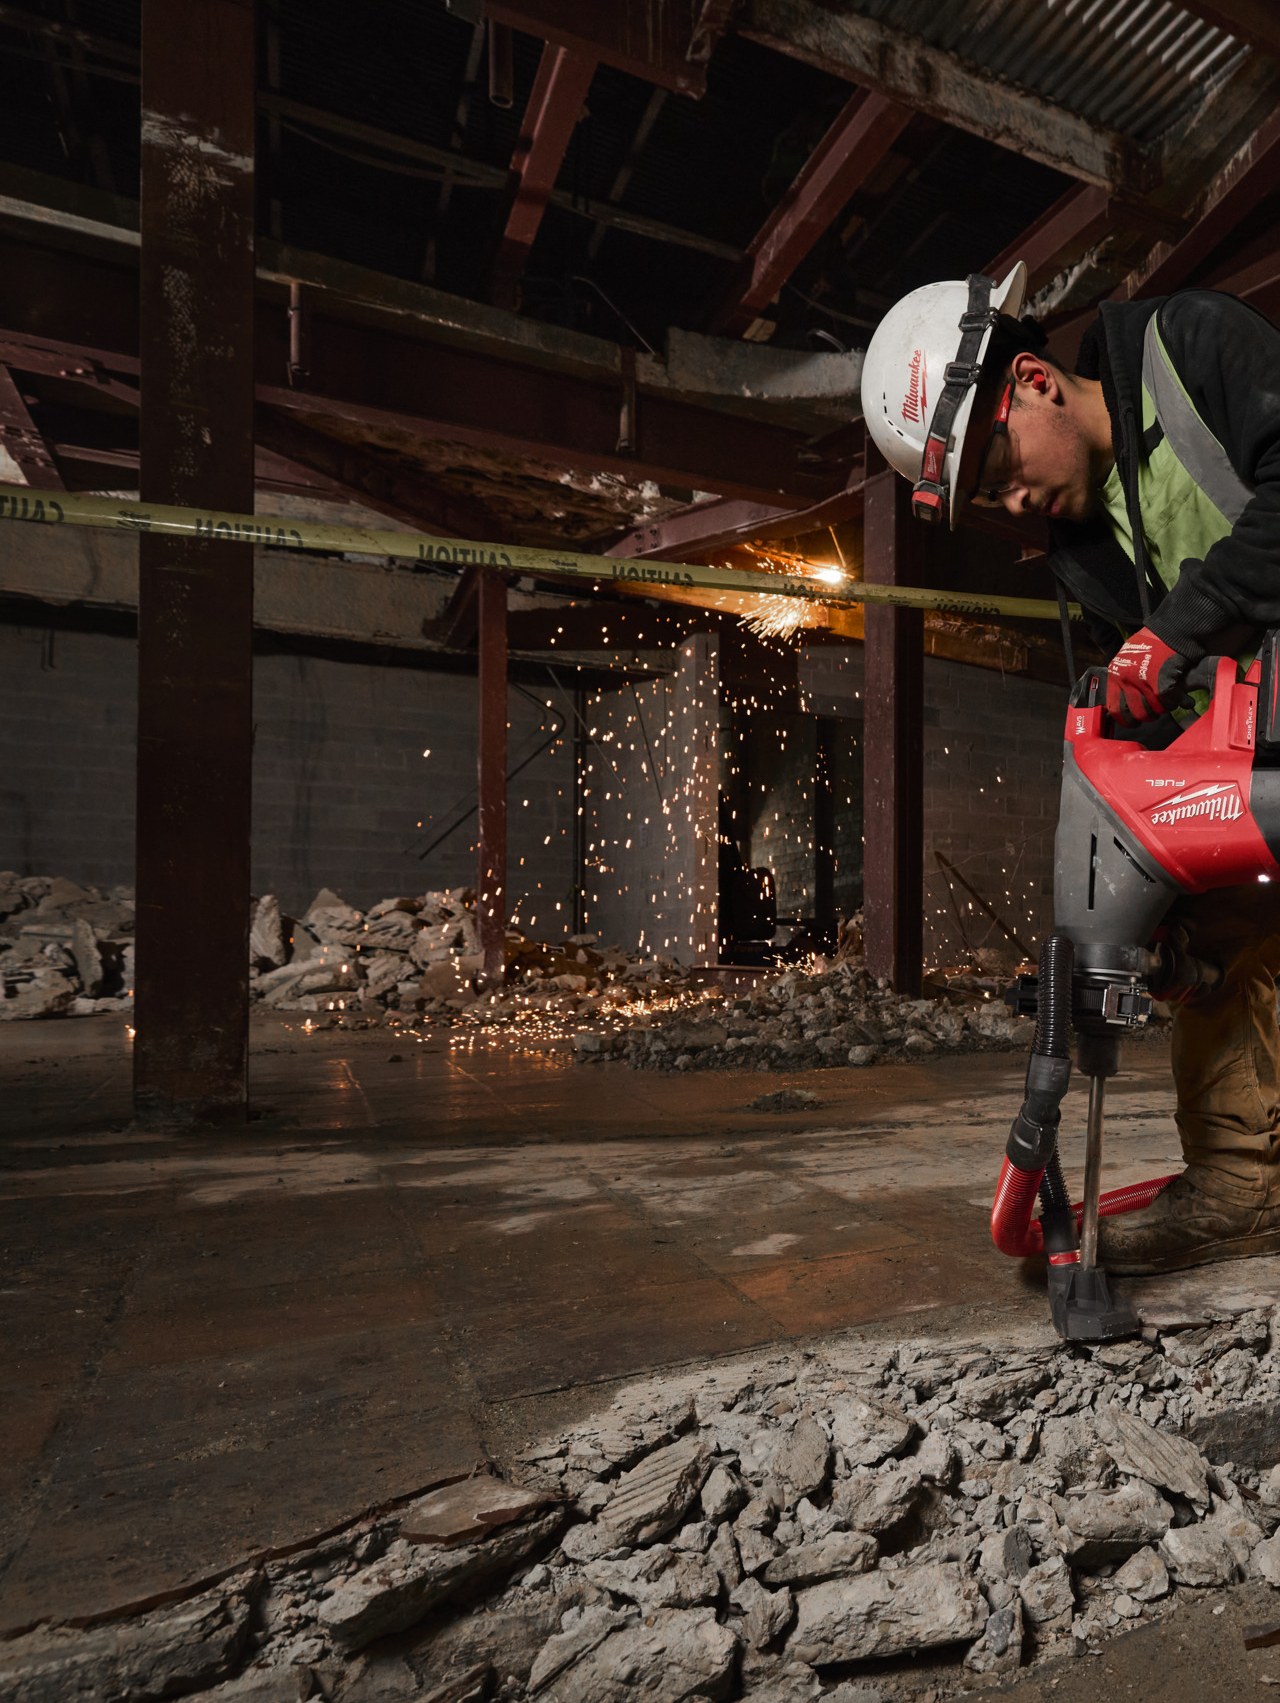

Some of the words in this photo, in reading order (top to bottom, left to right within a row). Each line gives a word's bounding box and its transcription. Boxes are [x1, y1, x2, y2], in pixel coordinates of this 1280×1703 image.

[902, 349, 922, 423] Milwaukee
[1145, 779, 1185, 787] FUEL
[1151, 794, 1244, 826] Milwaukee
